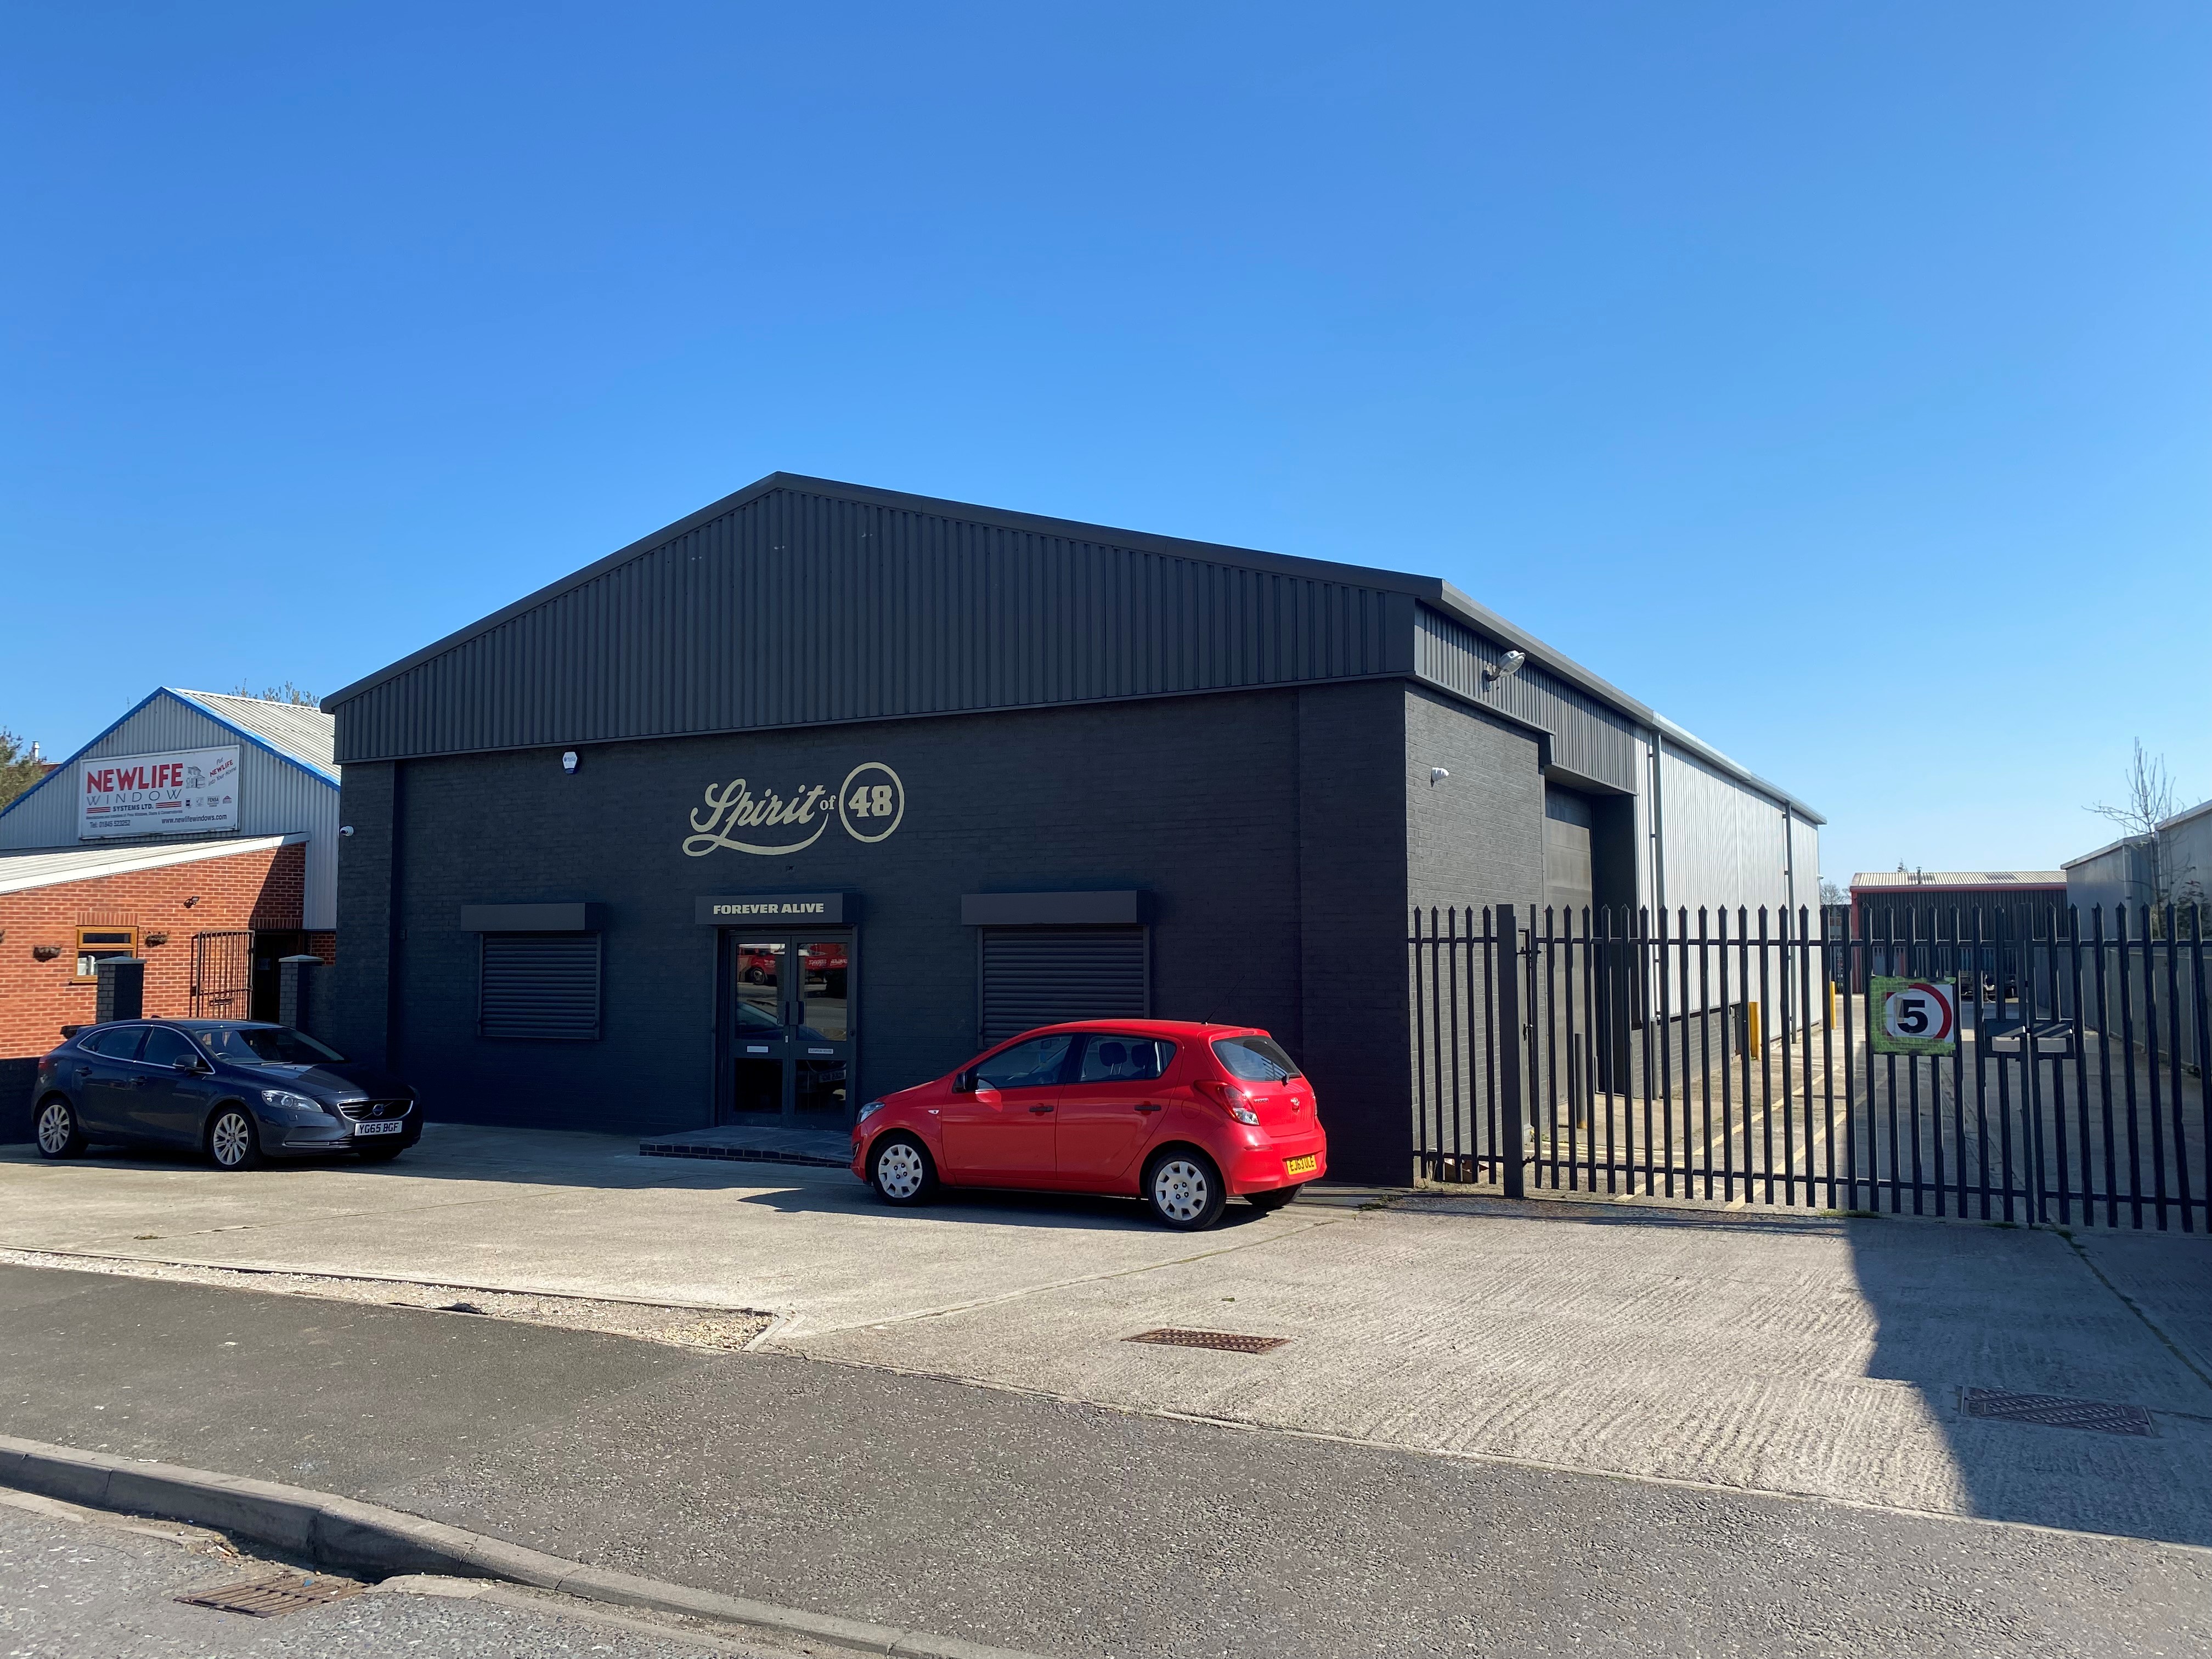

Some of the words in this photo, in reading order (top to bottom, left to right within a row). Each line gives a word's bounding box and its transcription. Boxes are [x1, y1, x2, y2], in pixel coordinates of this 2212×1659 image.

[210, 759, 234, 777] NEWLIFE
[87, 763, 183, 794] NEWLIFE
[86, 789, 182, 806] WINDOW
[161, 814, 227, 824] www.newlifewindows.com
[682, 778, 829, 856] Spirit
[819, 795, 837, 811] of
[848, 785, 893, 817] 48
[713, 904, 778, 915] FOREVER
[781, 902, 825, 913] ALIVE
[1897, 999, 1928, 1034] 5
[359, 1124, 381, 1133] YG65
[383, 1123, 399, 1132] BGF
[1290, 1159, 1304, 1171] EJ63
